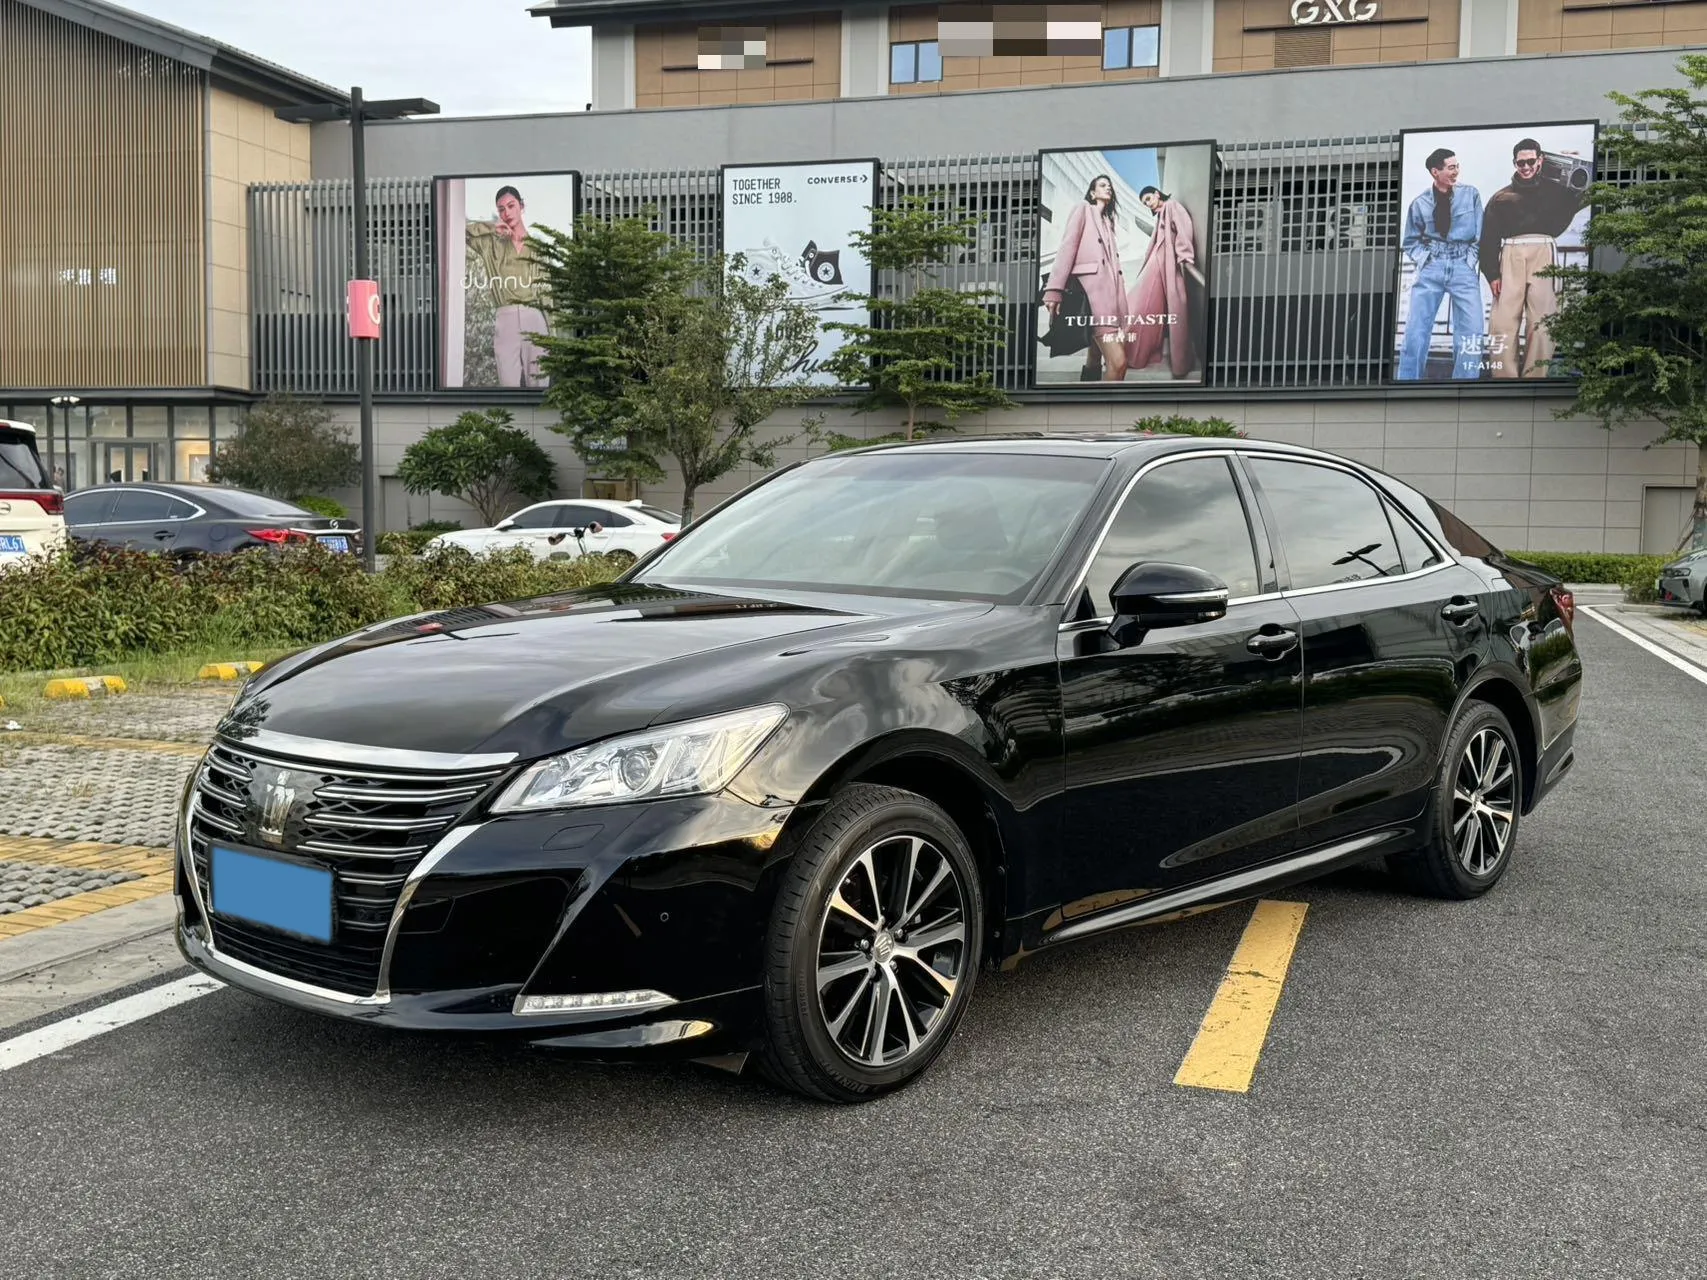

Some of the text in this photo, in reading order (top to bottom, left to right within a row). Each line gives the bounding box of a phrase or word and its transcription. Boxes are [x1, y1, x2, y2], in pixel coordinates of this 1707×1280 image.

[1291, 0, 1378, 24] GXG
[732, 178, 781, 191] TOGETHER
[807, 175, 858, 185] CONVERSE
[732, 191, 797, 205] SINCE 1908.
[1065, 313, 1178, 327] TULIP TASTE
[1461, 333, 1509, 355] 速写
[1462, 360, 1504, 371] 1F-A148
